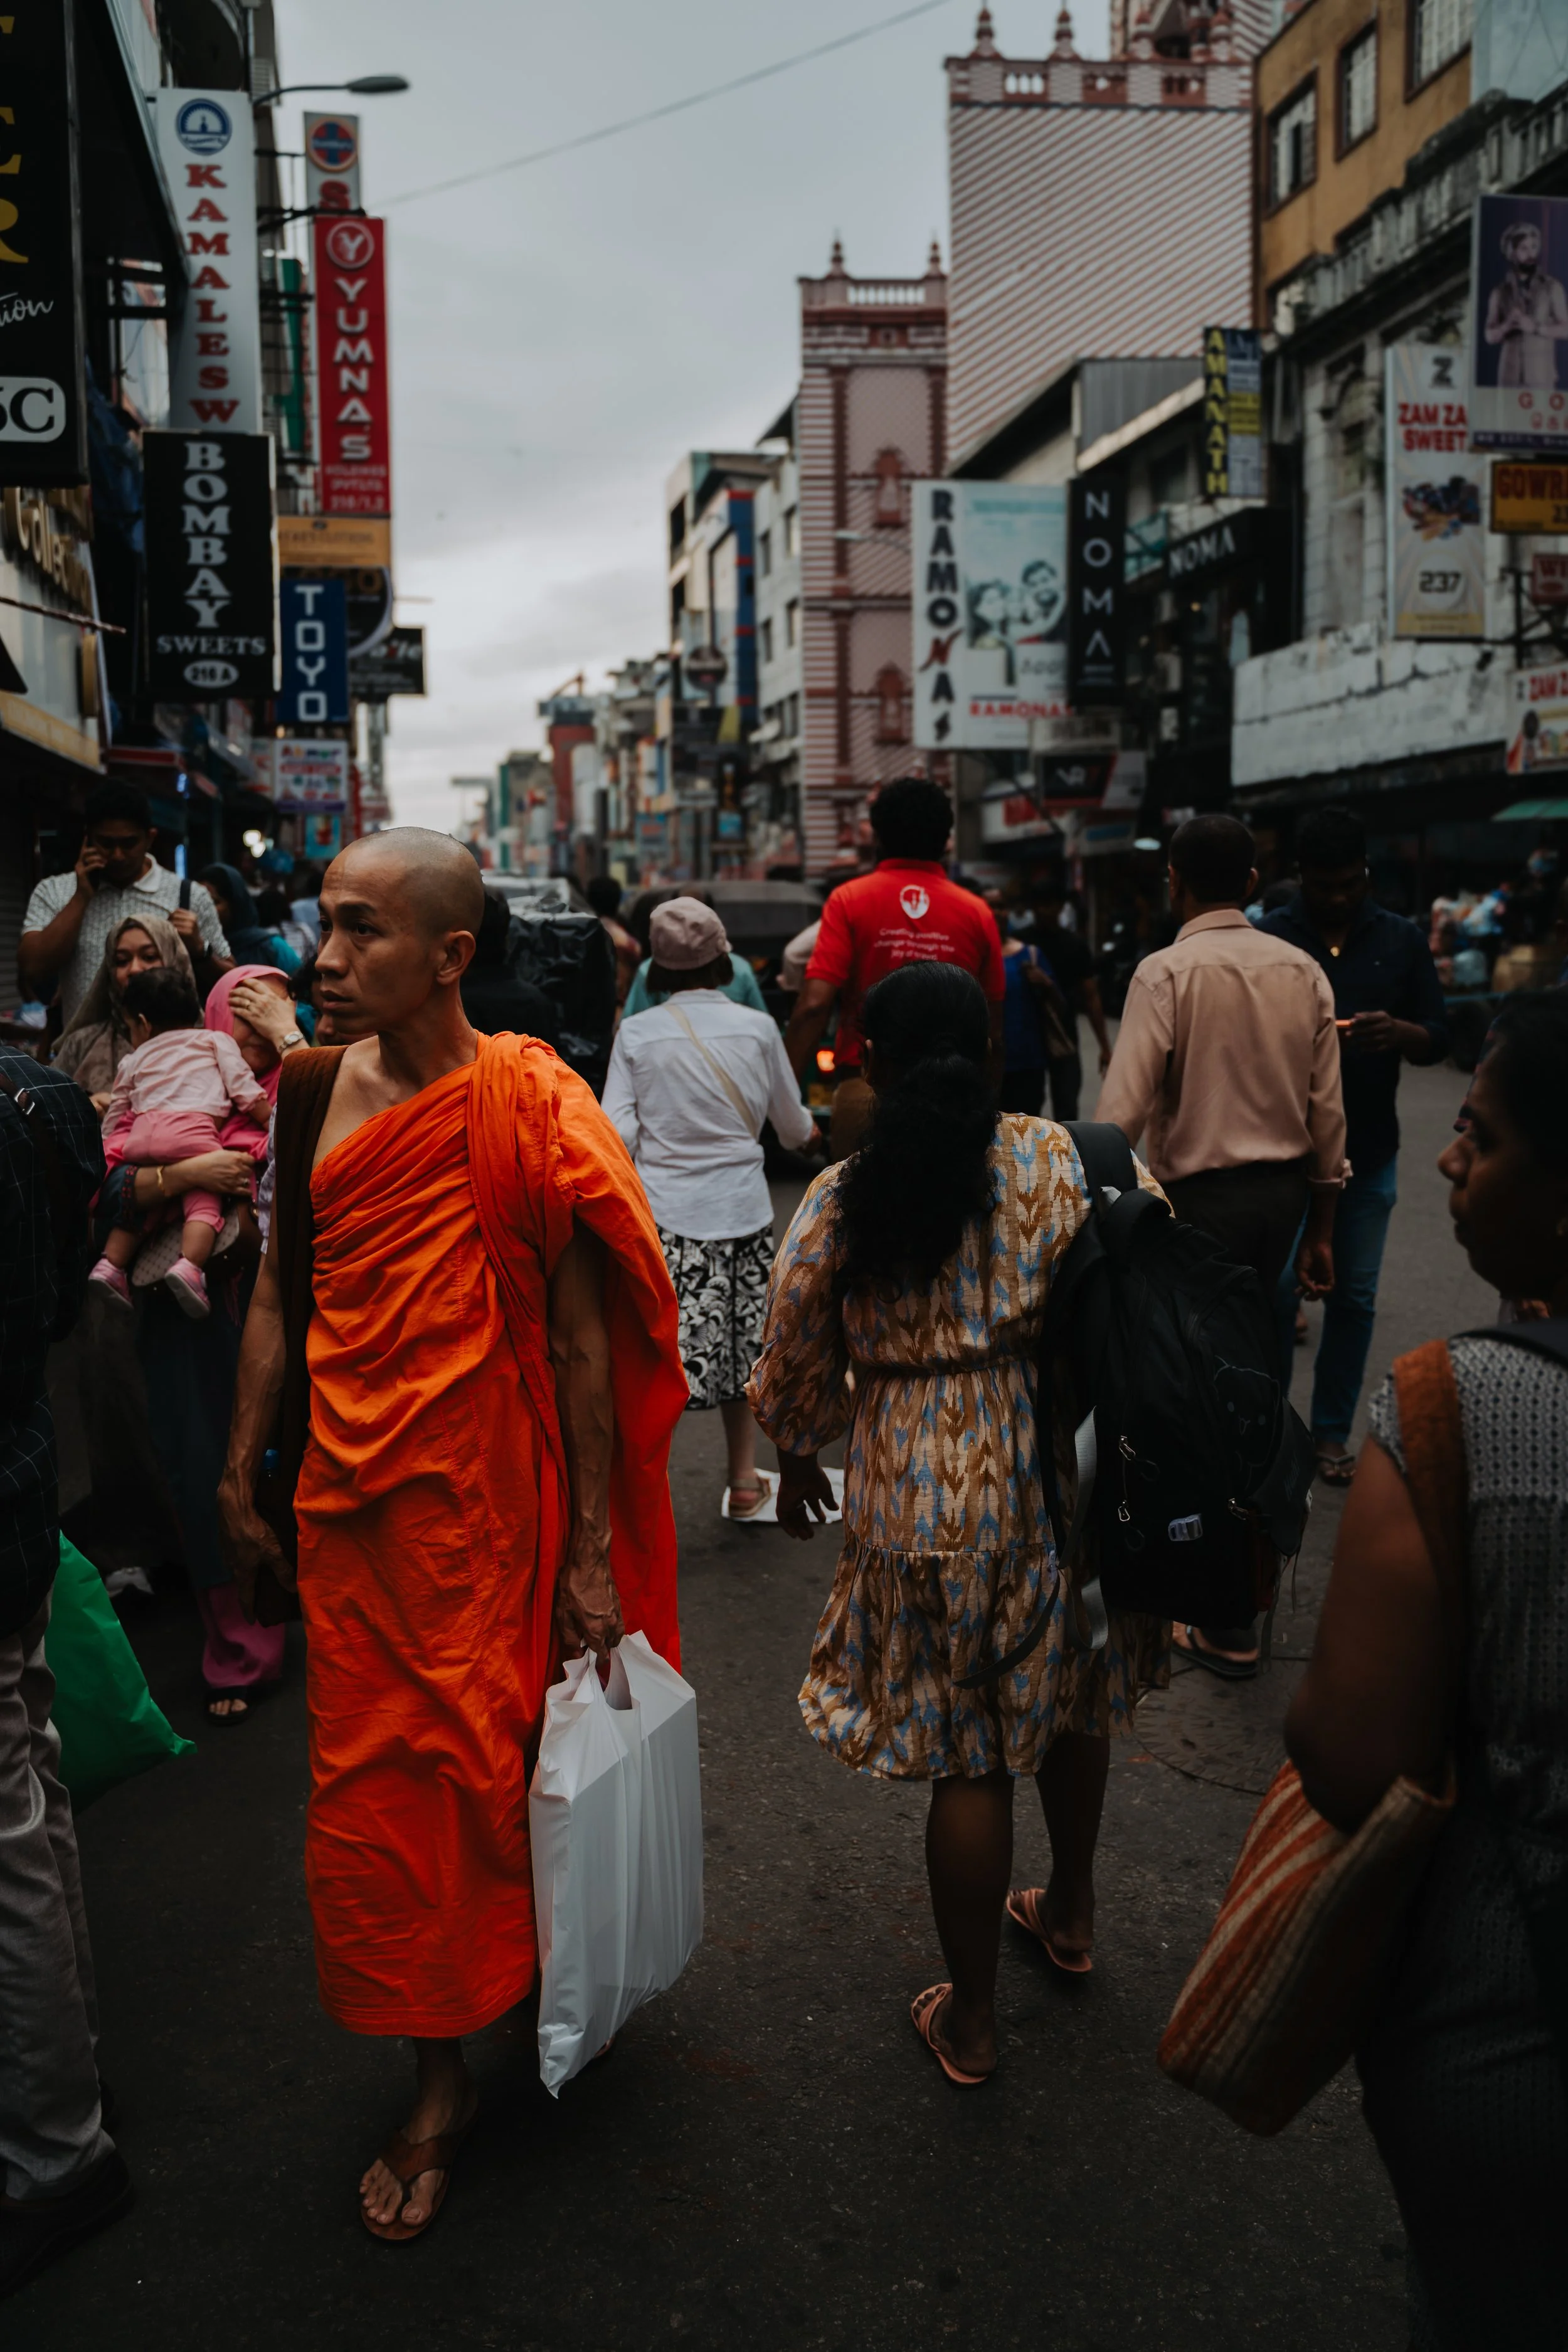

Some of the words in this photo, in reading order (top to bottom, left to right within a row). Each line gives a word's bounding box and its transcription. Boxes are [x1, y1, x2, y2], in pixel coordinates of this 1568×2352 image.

[1498, 467, 1568, 500] GOWR
[181, 441, 232, 628] BOMBAY
[1168, 525, 1236, 579] NOMA
[1083, 490, 1114, 657] NOMA
[1419, 571, 1462, 593] 237
[156, 635, 267, 655] SWEETS
[294, 584, 328, 722] TOYO
[874, 940, 905, 948] change
[906, 940, 940, 951] through
[940, 944, 955, 952] the
[879, 928, 914, 939] Creating
[916, 931, 950, 941] positive
[891, 949, 904, 958] joy
